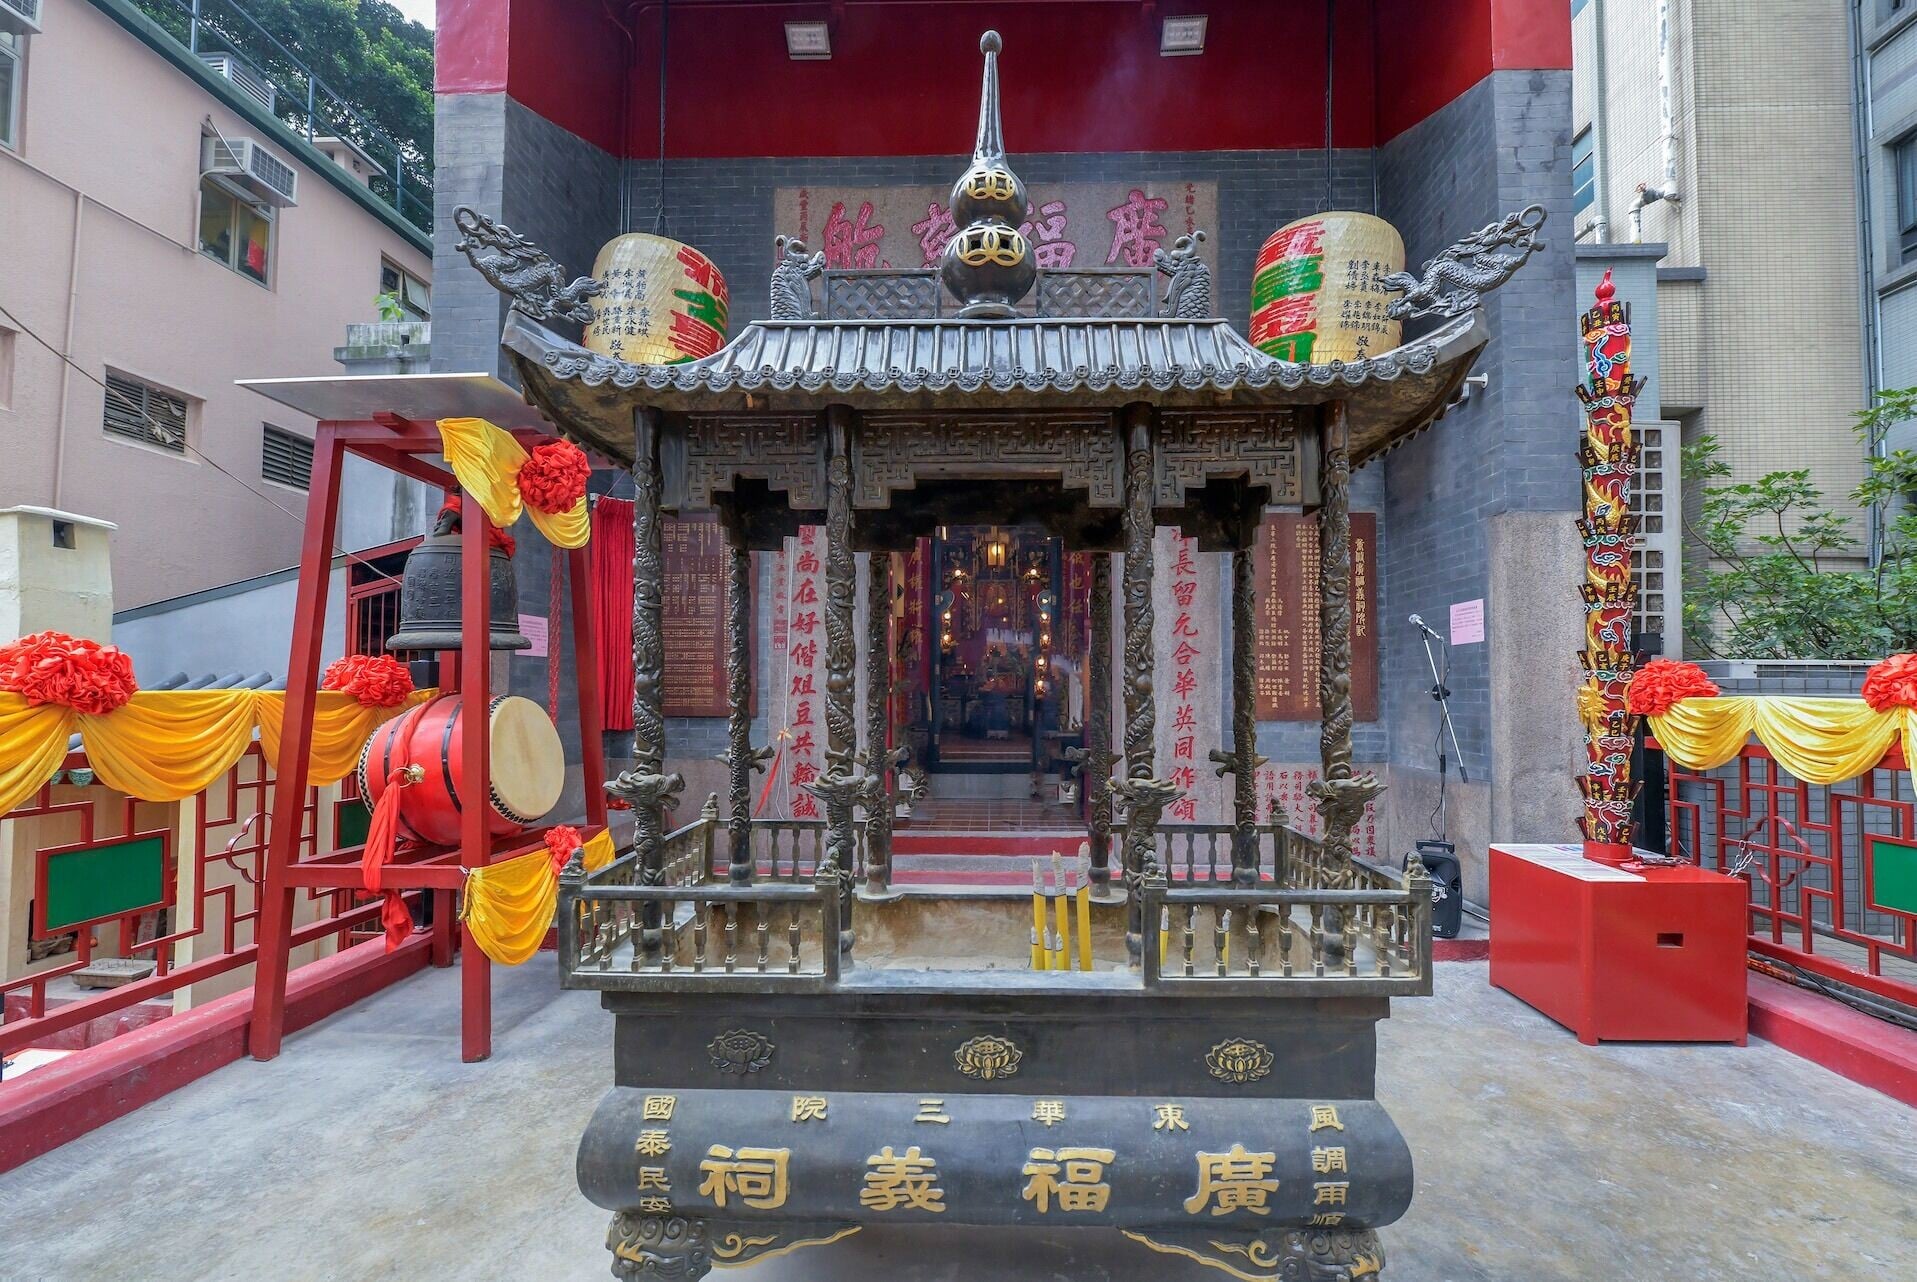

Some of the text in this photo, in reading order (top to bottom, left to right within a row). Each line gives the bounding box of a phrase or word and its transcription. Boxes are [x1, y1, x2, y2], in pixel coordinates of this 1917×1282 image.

[635, 1095, 678, 1214] 國泰民安
[699, 1143, 1281, 1217] 廣福義祠
[1309, 1103, 1351, 1228] 風調雨順
